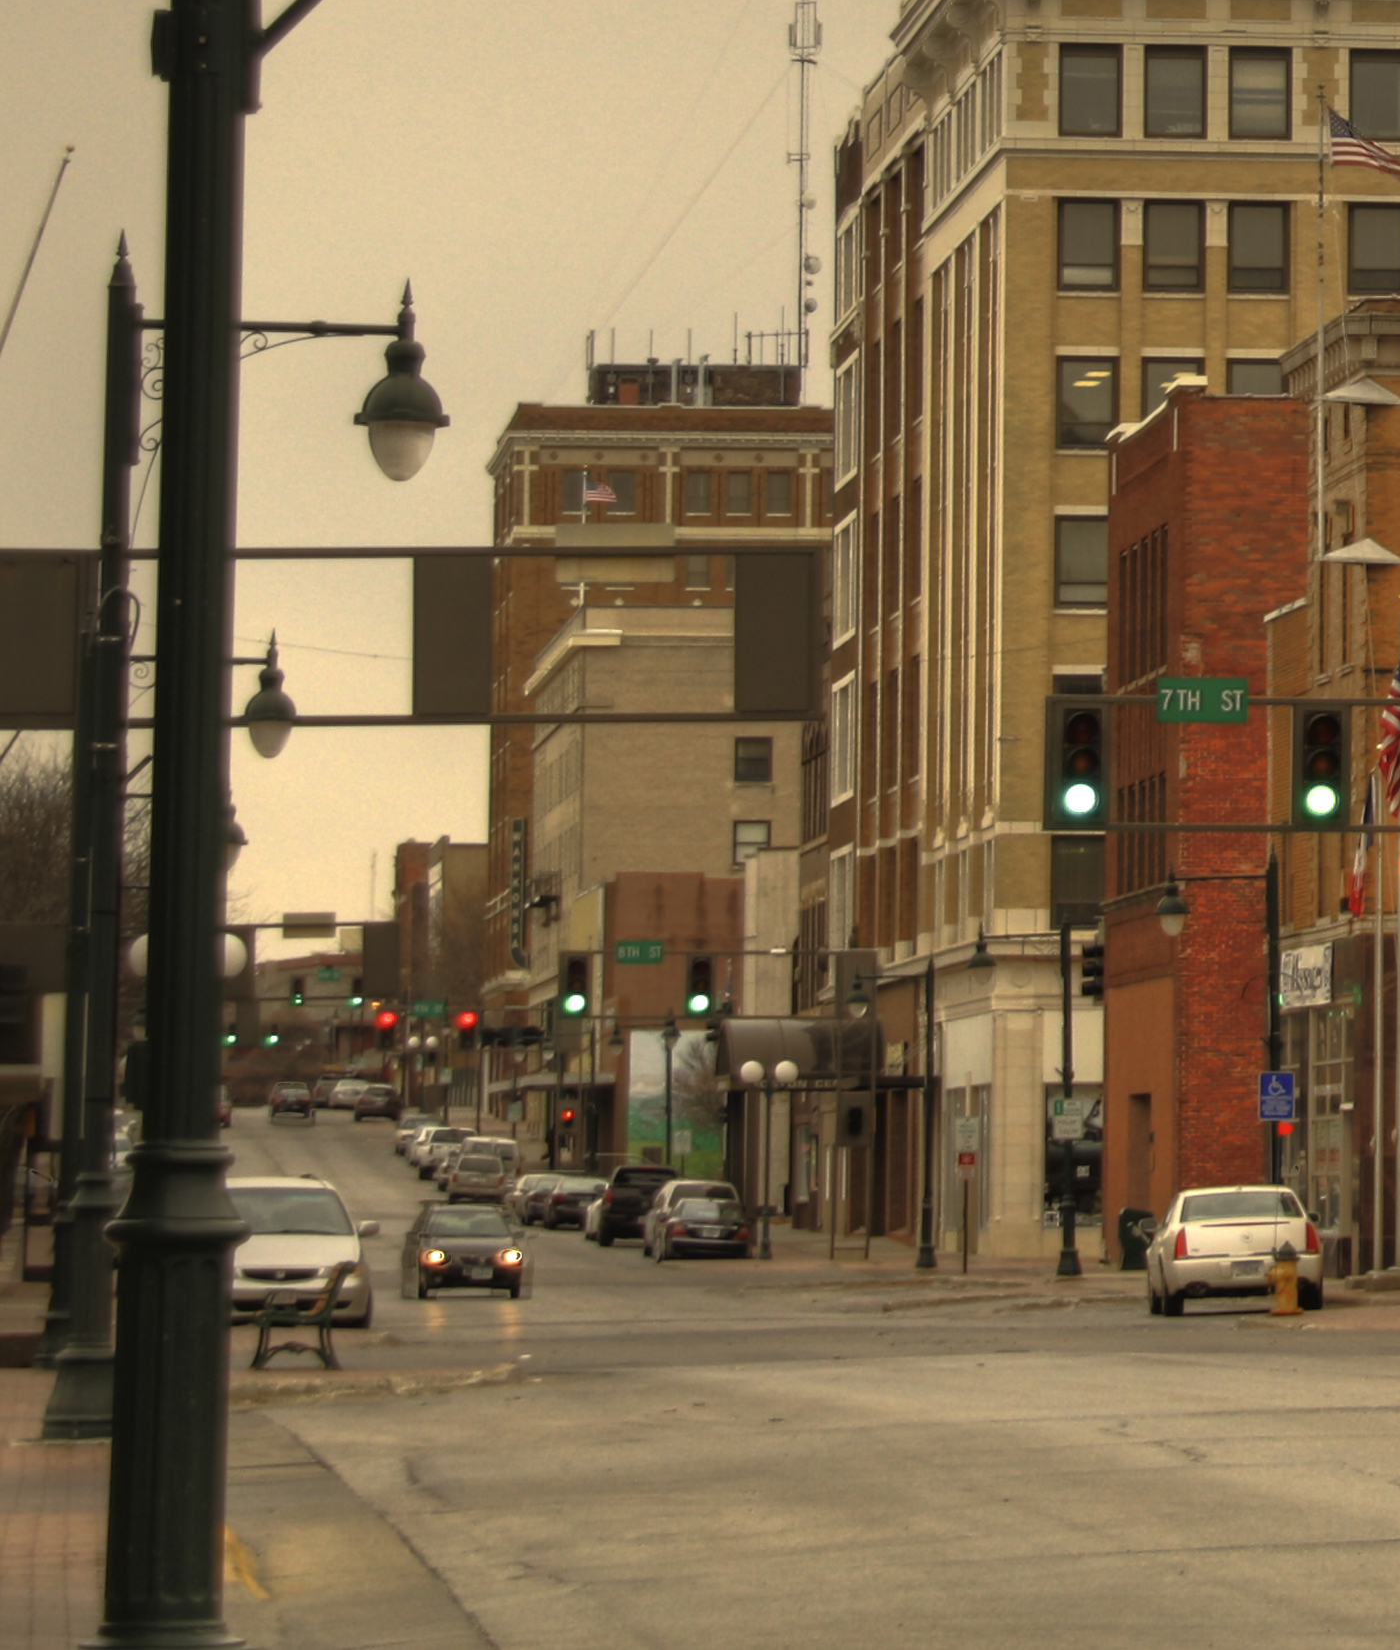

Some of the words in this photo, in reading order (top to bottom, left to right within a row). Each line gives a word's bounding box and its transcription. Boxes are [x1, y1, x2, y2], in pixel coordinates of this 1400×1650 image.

[1161, 689, 1200, 711] 7TH
[1221, 689, 1244, 711] ST
[617, 945, 640, 959] 8TH
[649, 945, 662, 959] ST
